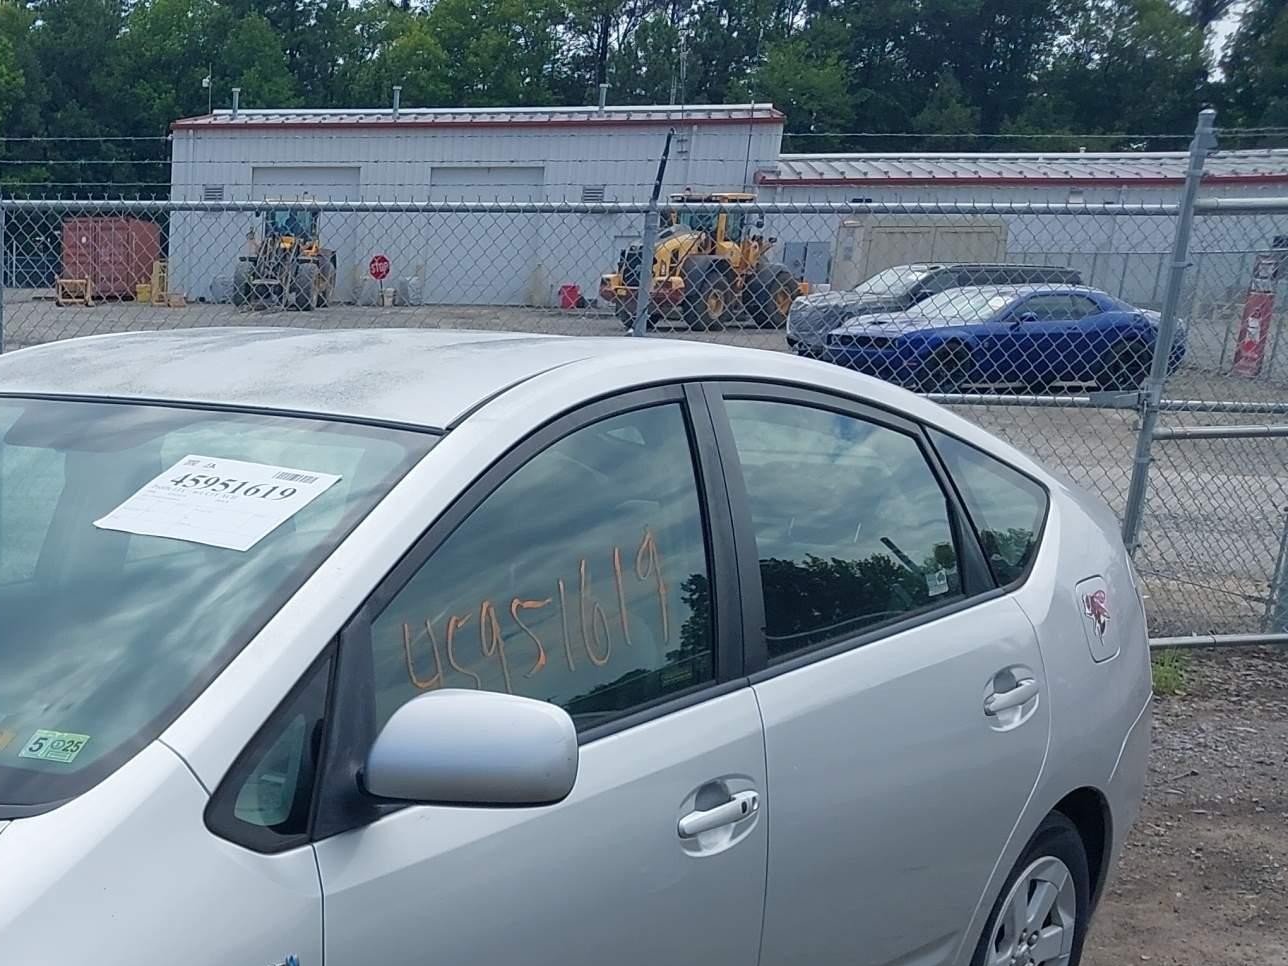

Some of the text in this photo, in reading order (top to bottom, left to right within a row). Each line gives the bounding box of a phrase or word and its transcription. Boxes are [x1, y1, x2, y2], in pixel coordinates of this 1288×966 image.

[371, 261, 389, 274] STOP
[170, 473, 298, 501] 45951619
[28, 737, 83, 753] 5 25
